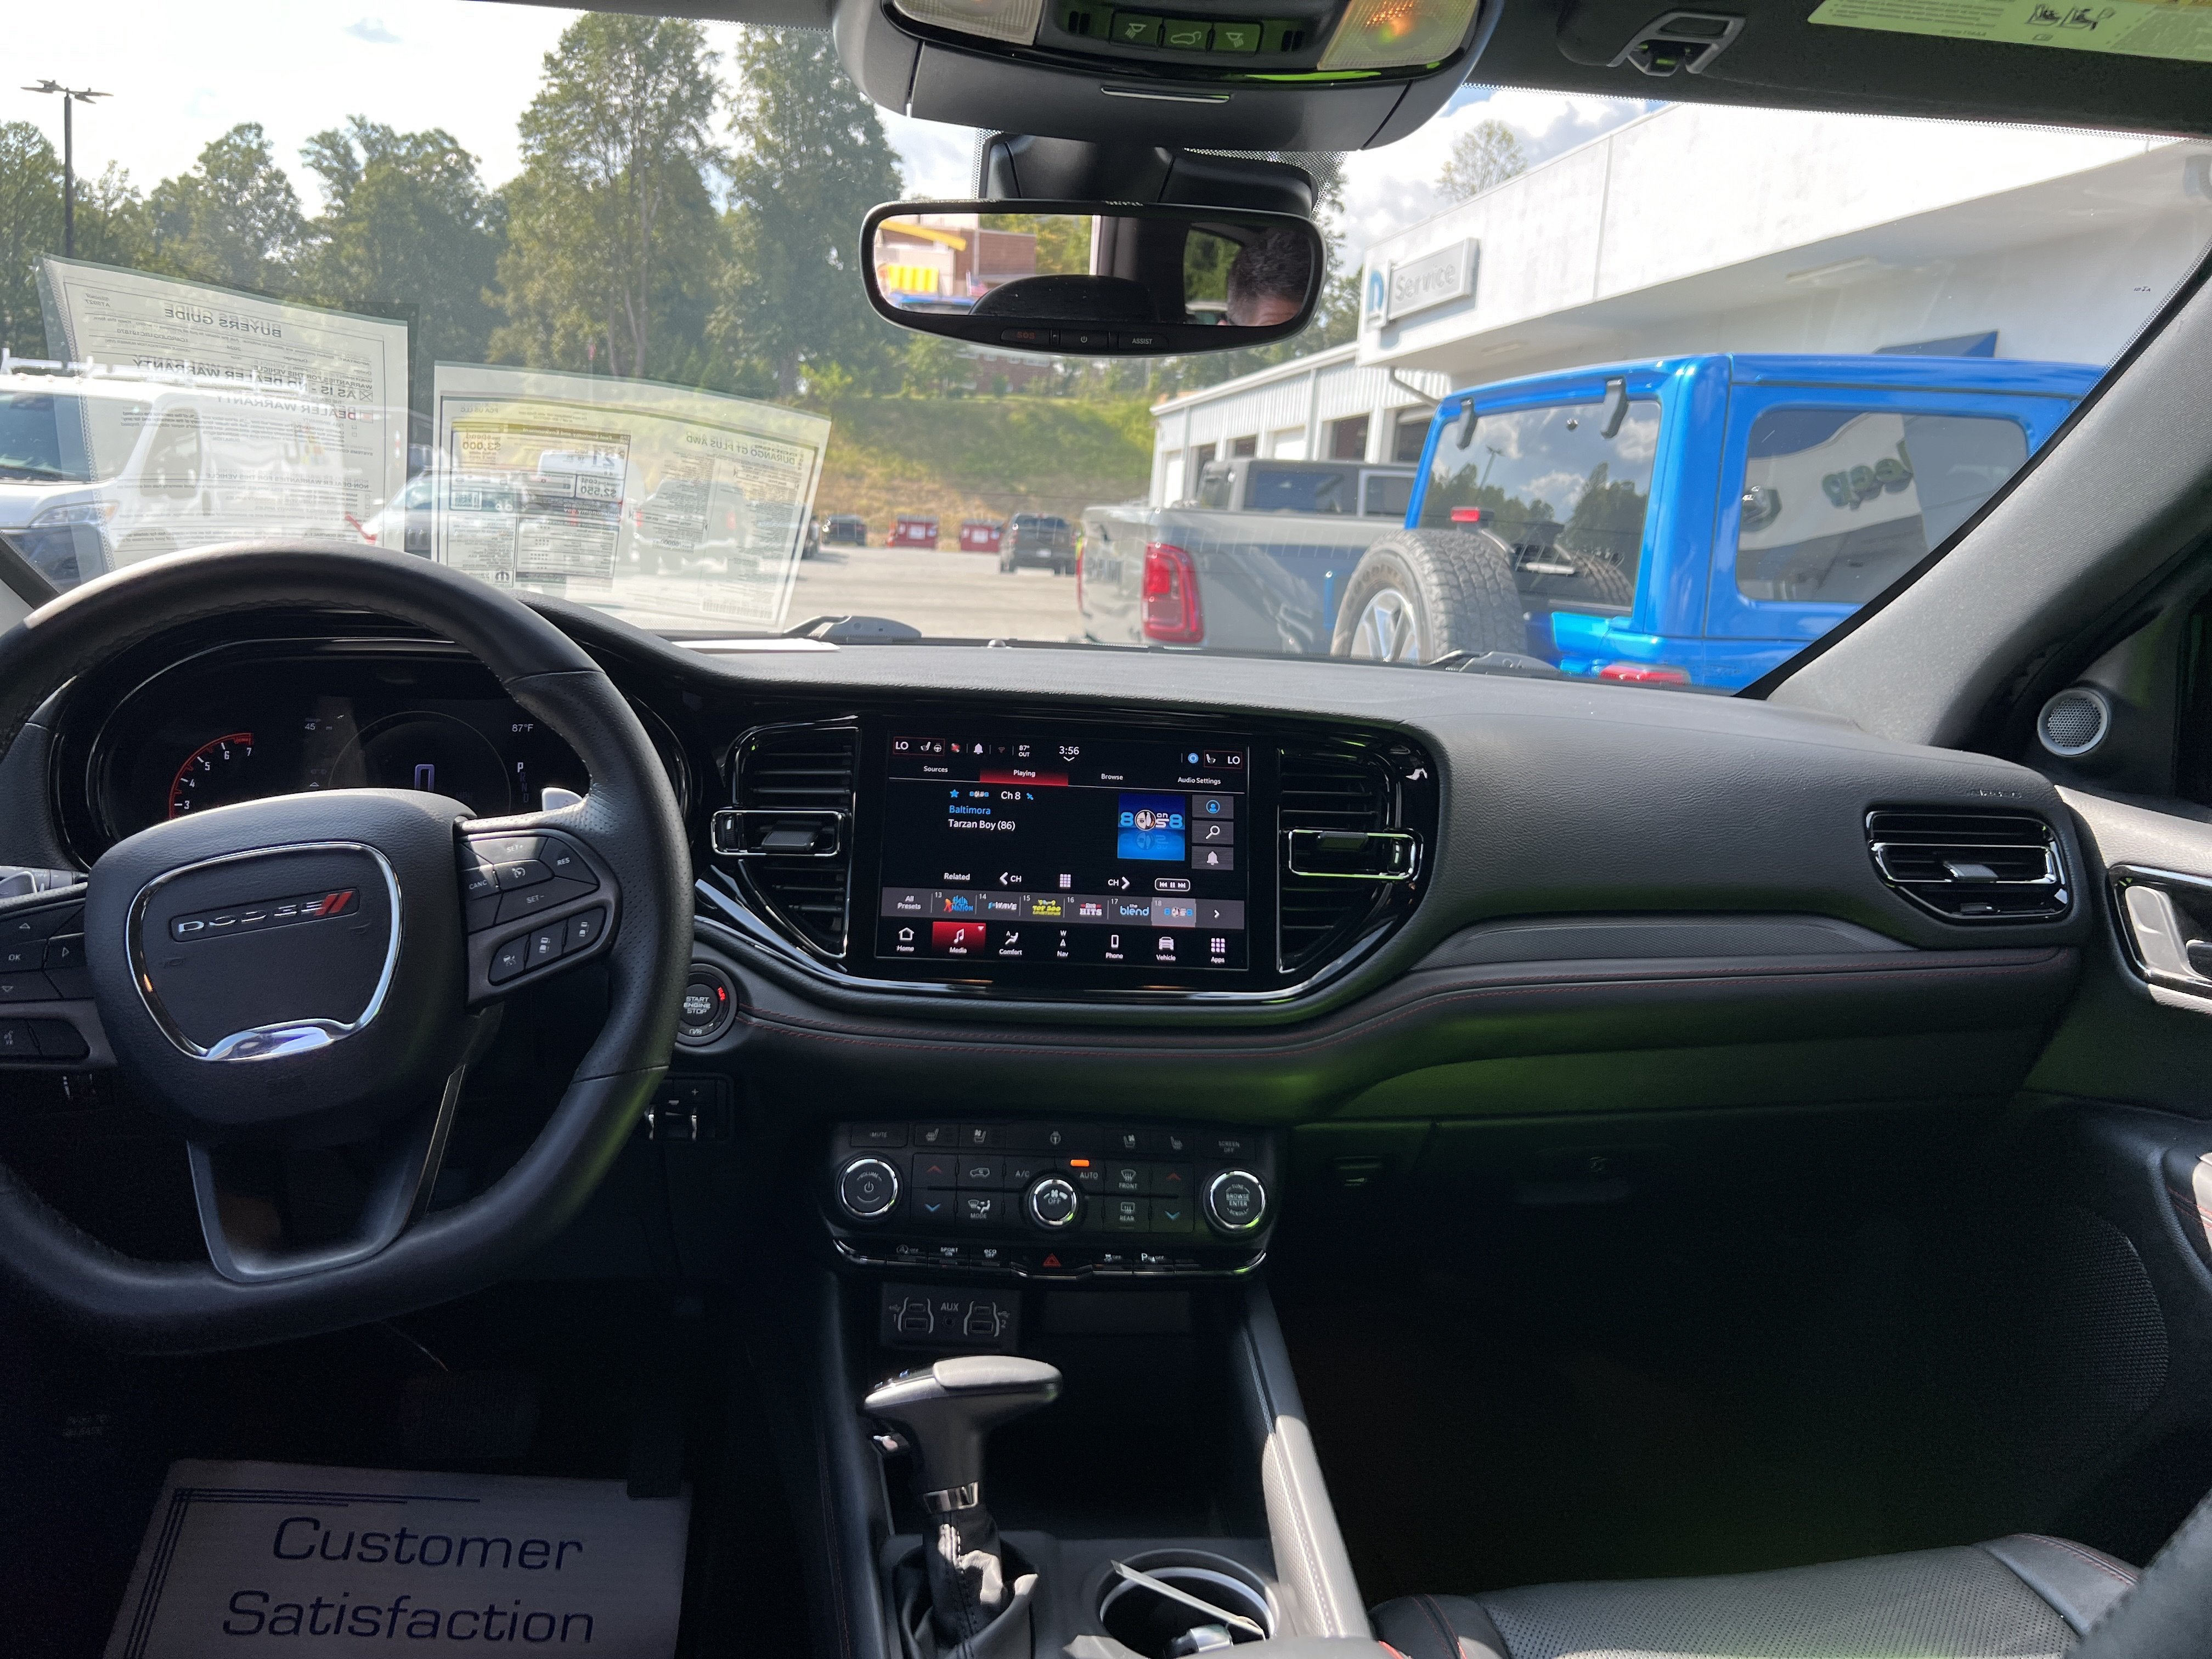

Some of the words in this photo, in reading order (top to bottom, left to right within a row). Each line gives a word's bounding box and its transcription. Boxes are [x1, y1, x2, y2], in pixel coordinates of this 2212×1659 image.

[1395, 263, 1456, 302] Service
[1017, 331, 1036, 339] SOS
[895, 741, 910, 751] LO
[1059, 746, 1080, 755] 3:56
[224, 751, 230, 760] 6
[246, 747, 252, 757] 7
[1227, 755, 1240, 765] LO
[205, 761, 211, 771] 5
[517, 761, 524, 773] P
[923, 765, 949, 774] Sources
[1013, 769, 1036, 778] Playing
[189, 778, 195, 788] 4
[1196, 777, 1221, 786] Settings
[1000, 791, 1014, 800] Ch
[1014, 791, 1022, 800] 8
[184, 799, 190, 810] 3
[949, 805, 991, 815] Baltimora
[948, 818, 977, 828] Tarzan
[979, 820, 996, 830] Boy
[997, 821, 1016, 832] (86)
[556, 857, 571, 866] RES
[943, 872, 970, 881] Related
[469, 879, 488, 890] CANC
[897, 902, 922, 910] Presets
[950, 904, 974, 912] NATION
[995, 901, 1018, 910] WAVE
[1079, 907, 1102, 916] HITS
[1120, 905, 1149, 917] blend
[178, 900, 325, 934] DODGE
[8, 953, 23, 962] OK
[1156, 954, 1176, 962] Vehicle
[1211, 956, 1226, 964] Apps
[1014, 1169, 1030, 1179] A/C
[1079, 1171, 1099, 1181] AUTO
[940, 1302, 960, 1312] AUX
[272, 1515, 583, 1572] Customer
[221, 1589, 595, 1644] Satisfaction
